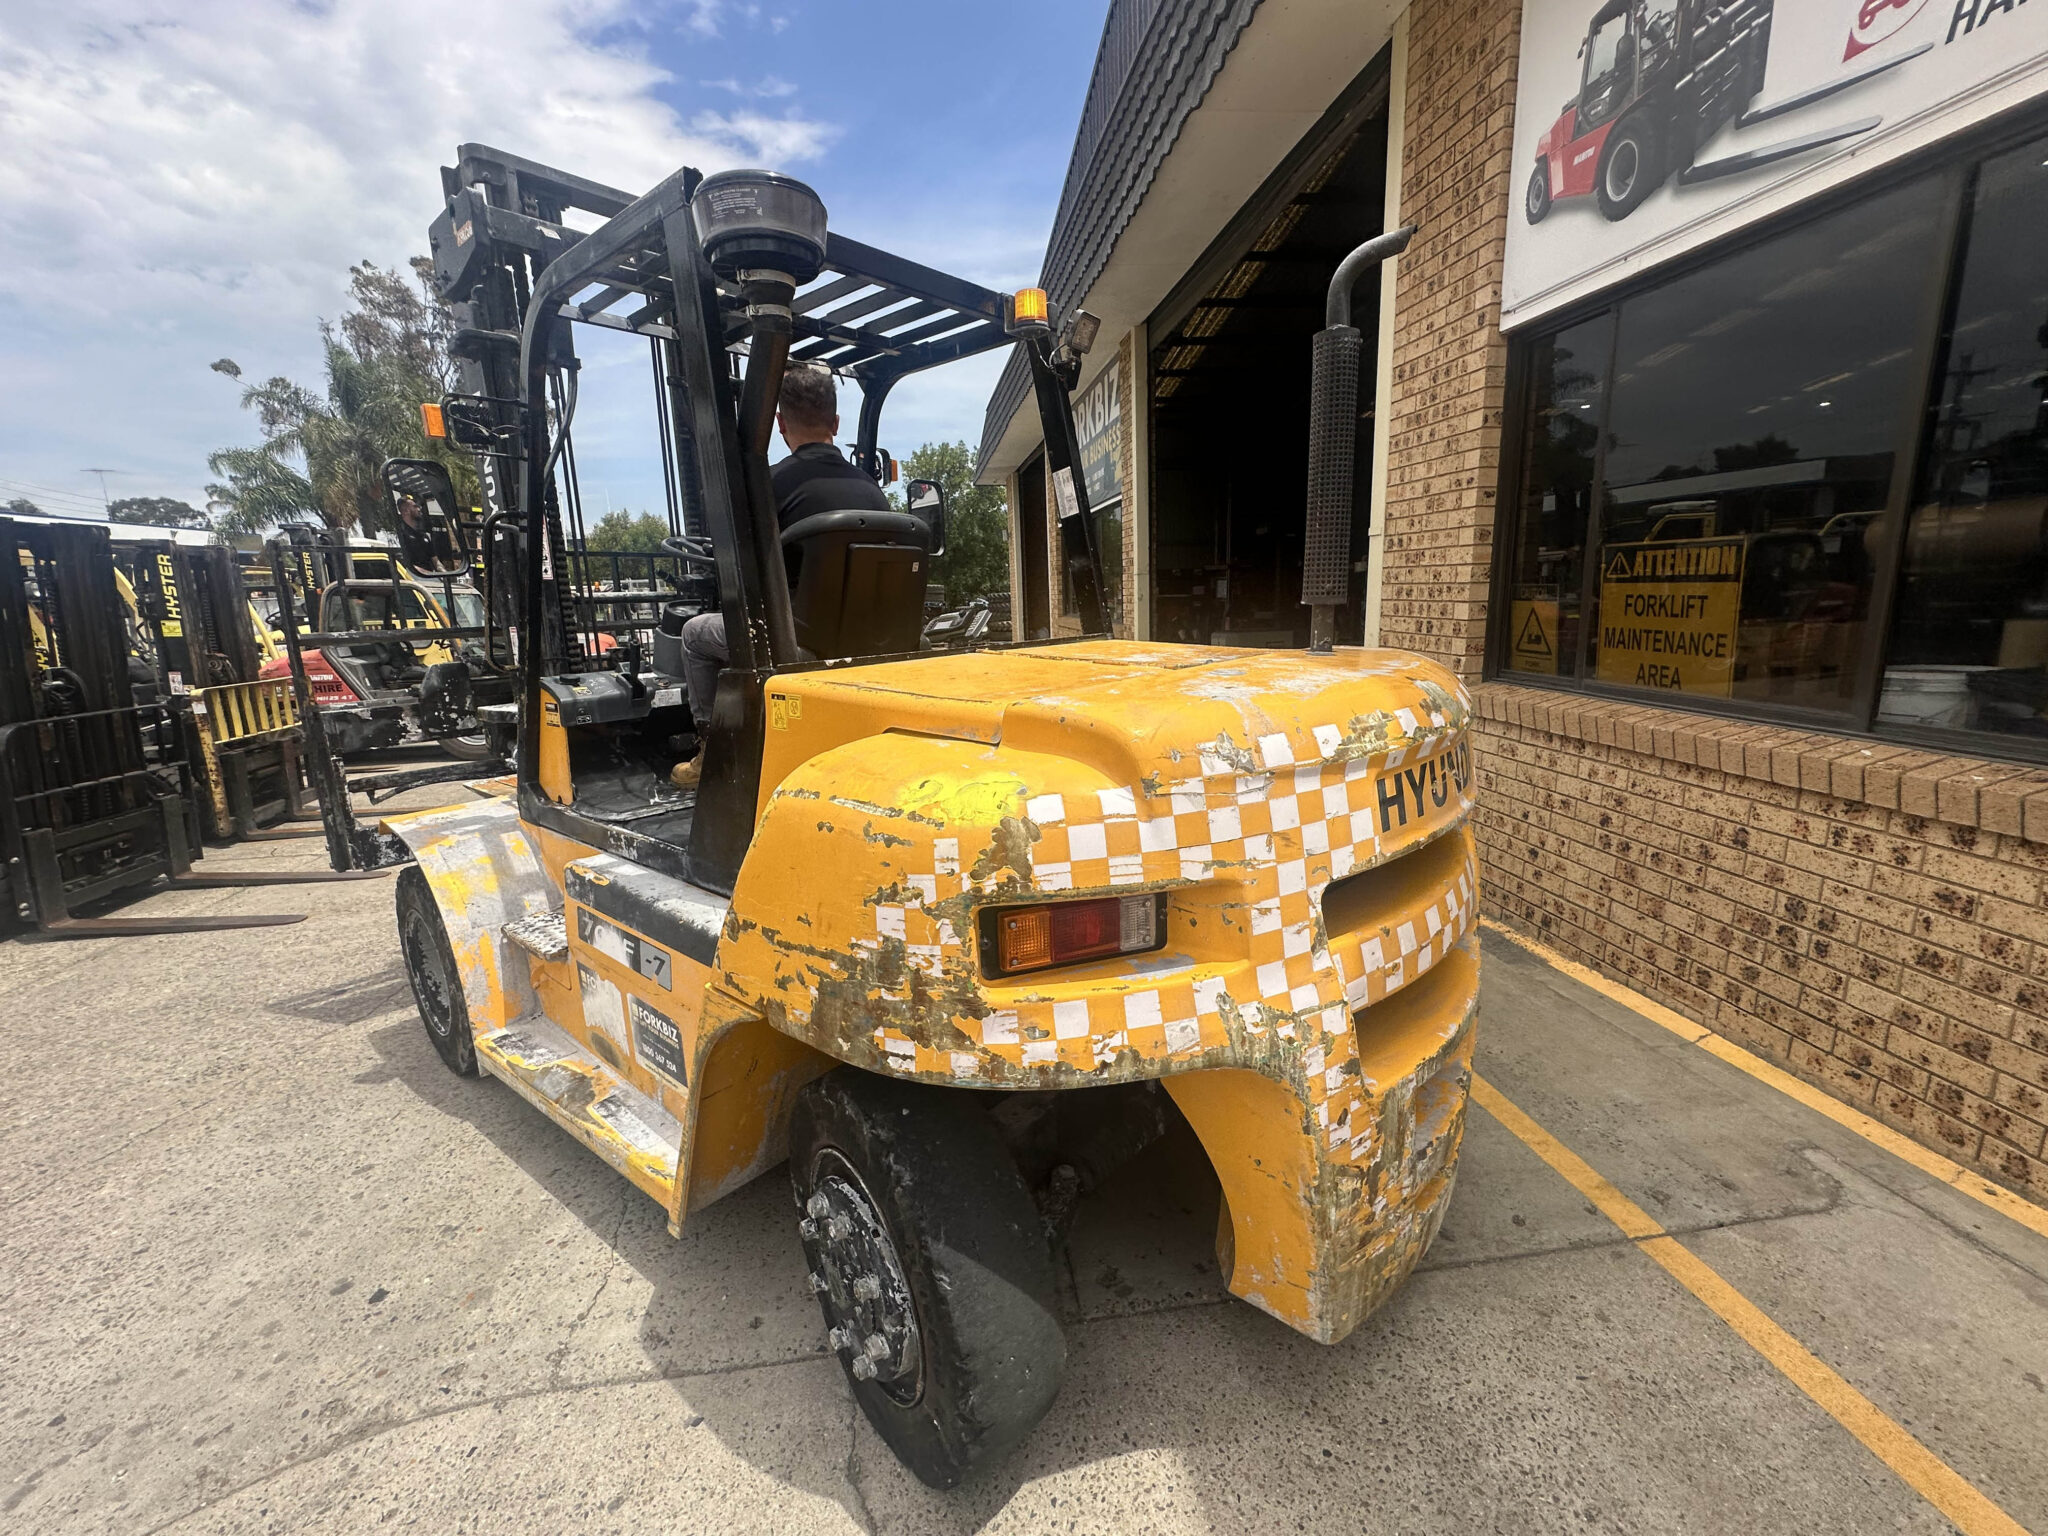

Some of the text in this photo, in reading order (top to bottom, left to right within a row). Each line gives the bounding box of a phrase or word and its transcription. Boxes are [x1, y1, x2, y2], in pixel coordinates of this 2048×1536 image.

[302, 551, 316, 589] HYSTER
[1632, 545, 1738, 577] ATTENTION
[157, 554, 181, 619] HYSTER
[1624, 593, 1709, 619] FORKLIFT
[1603, 626, 1728, 658] MAINTENANCE
[313, 684, 343, 693] HIRE
[1635, 663, 1682, 690] AREA
[638, 1006, 679, 1043] FORKBIZ
